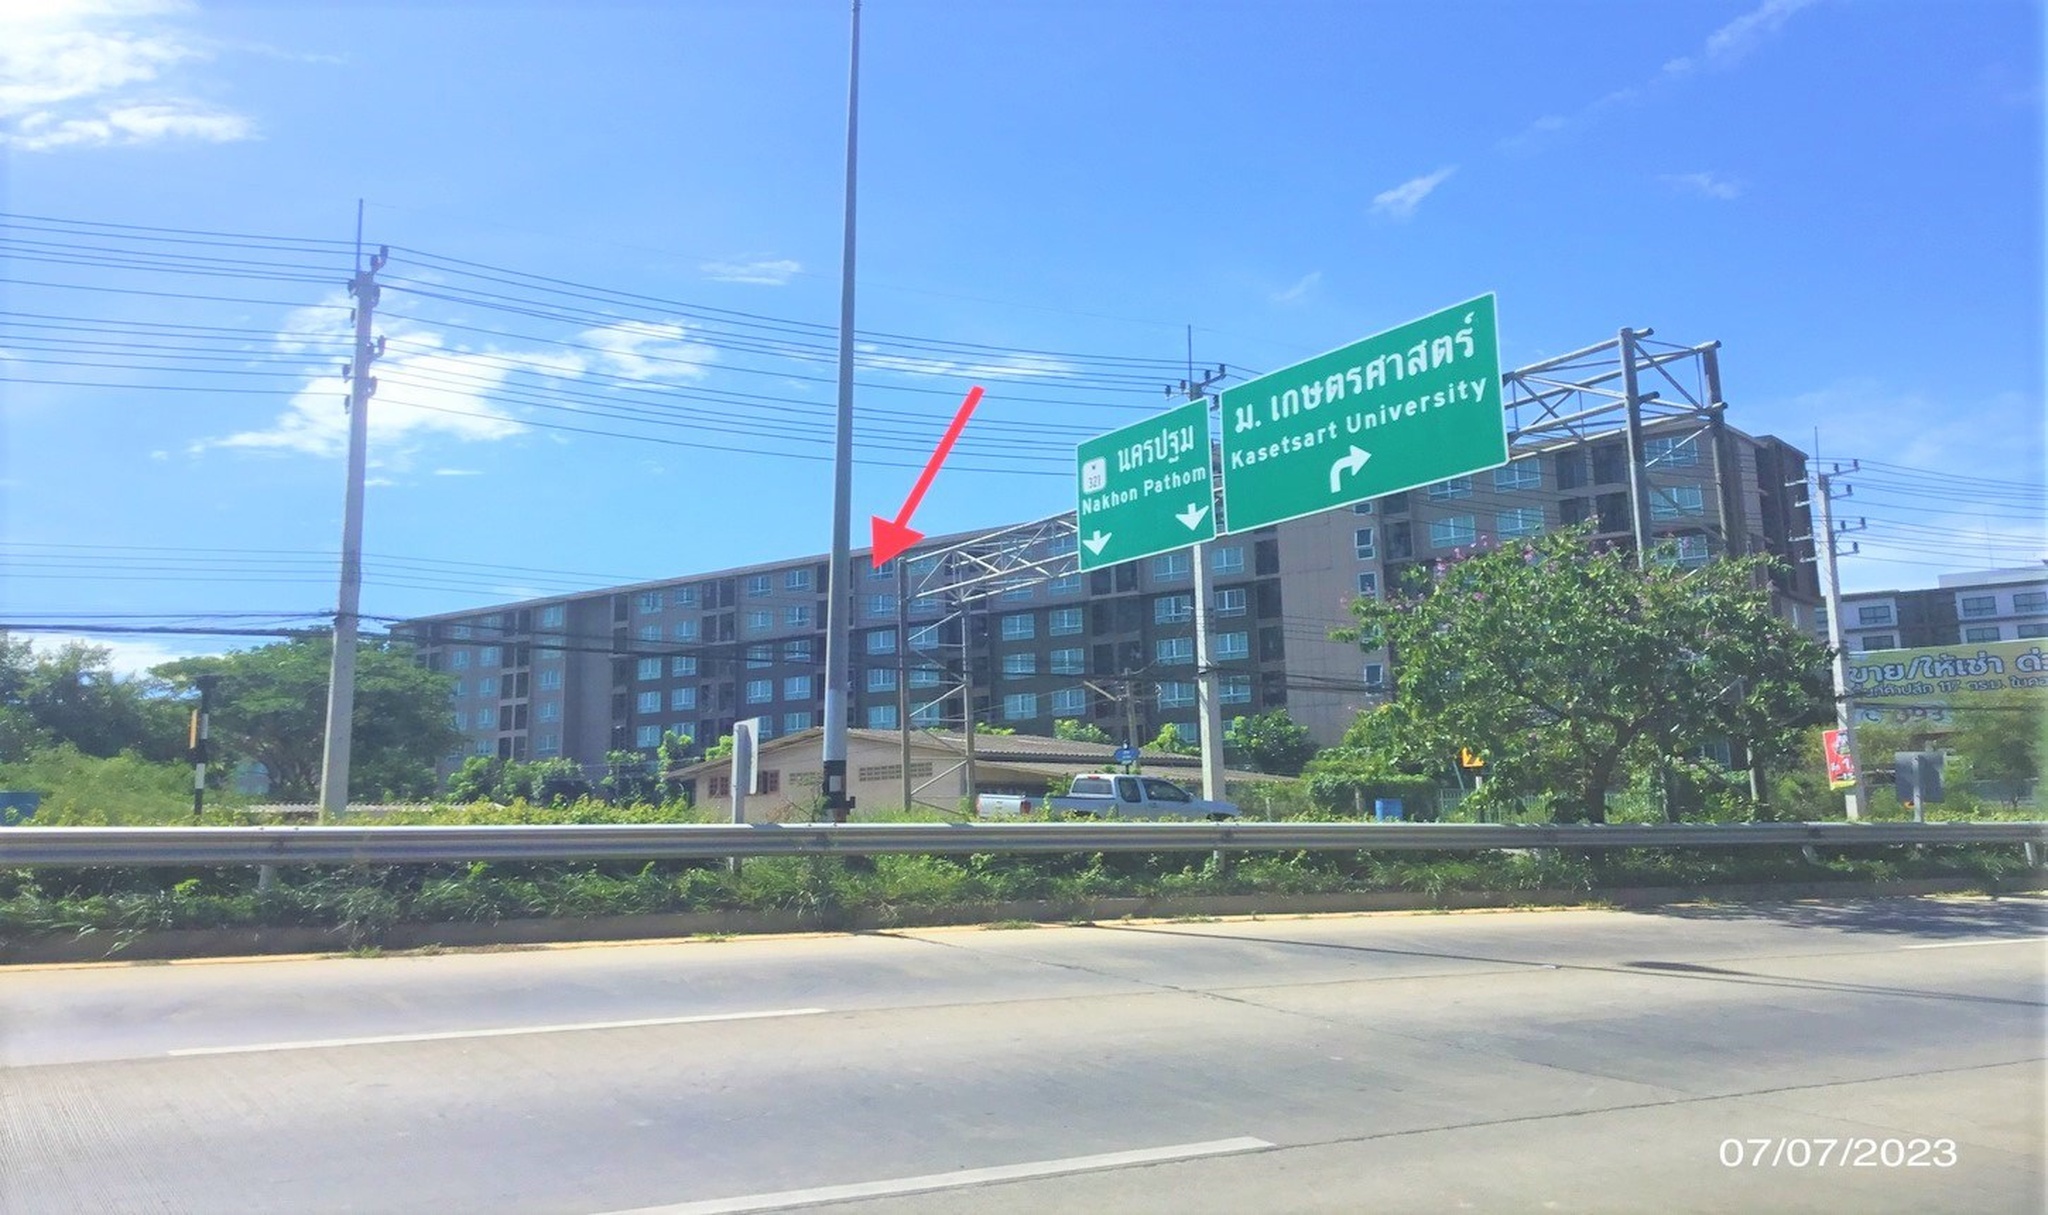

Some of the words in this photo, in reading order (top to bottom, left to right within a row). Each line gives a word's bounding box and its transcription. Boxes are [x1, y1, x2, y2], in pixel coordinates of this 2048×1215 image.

[1235, 404, 1261, 433] ม.
[1271, 311, 1475, 421] เกษตรศาสตร์
[1117, 425, 1194, 473] นครปฐม
[1231, 420, 1338, 470] Kasetsart
[1346, 377, 1487, 434] University
[1082, 488, 1138, 515] Nakhon
[1144, 467, 1206, 497] Pathom
